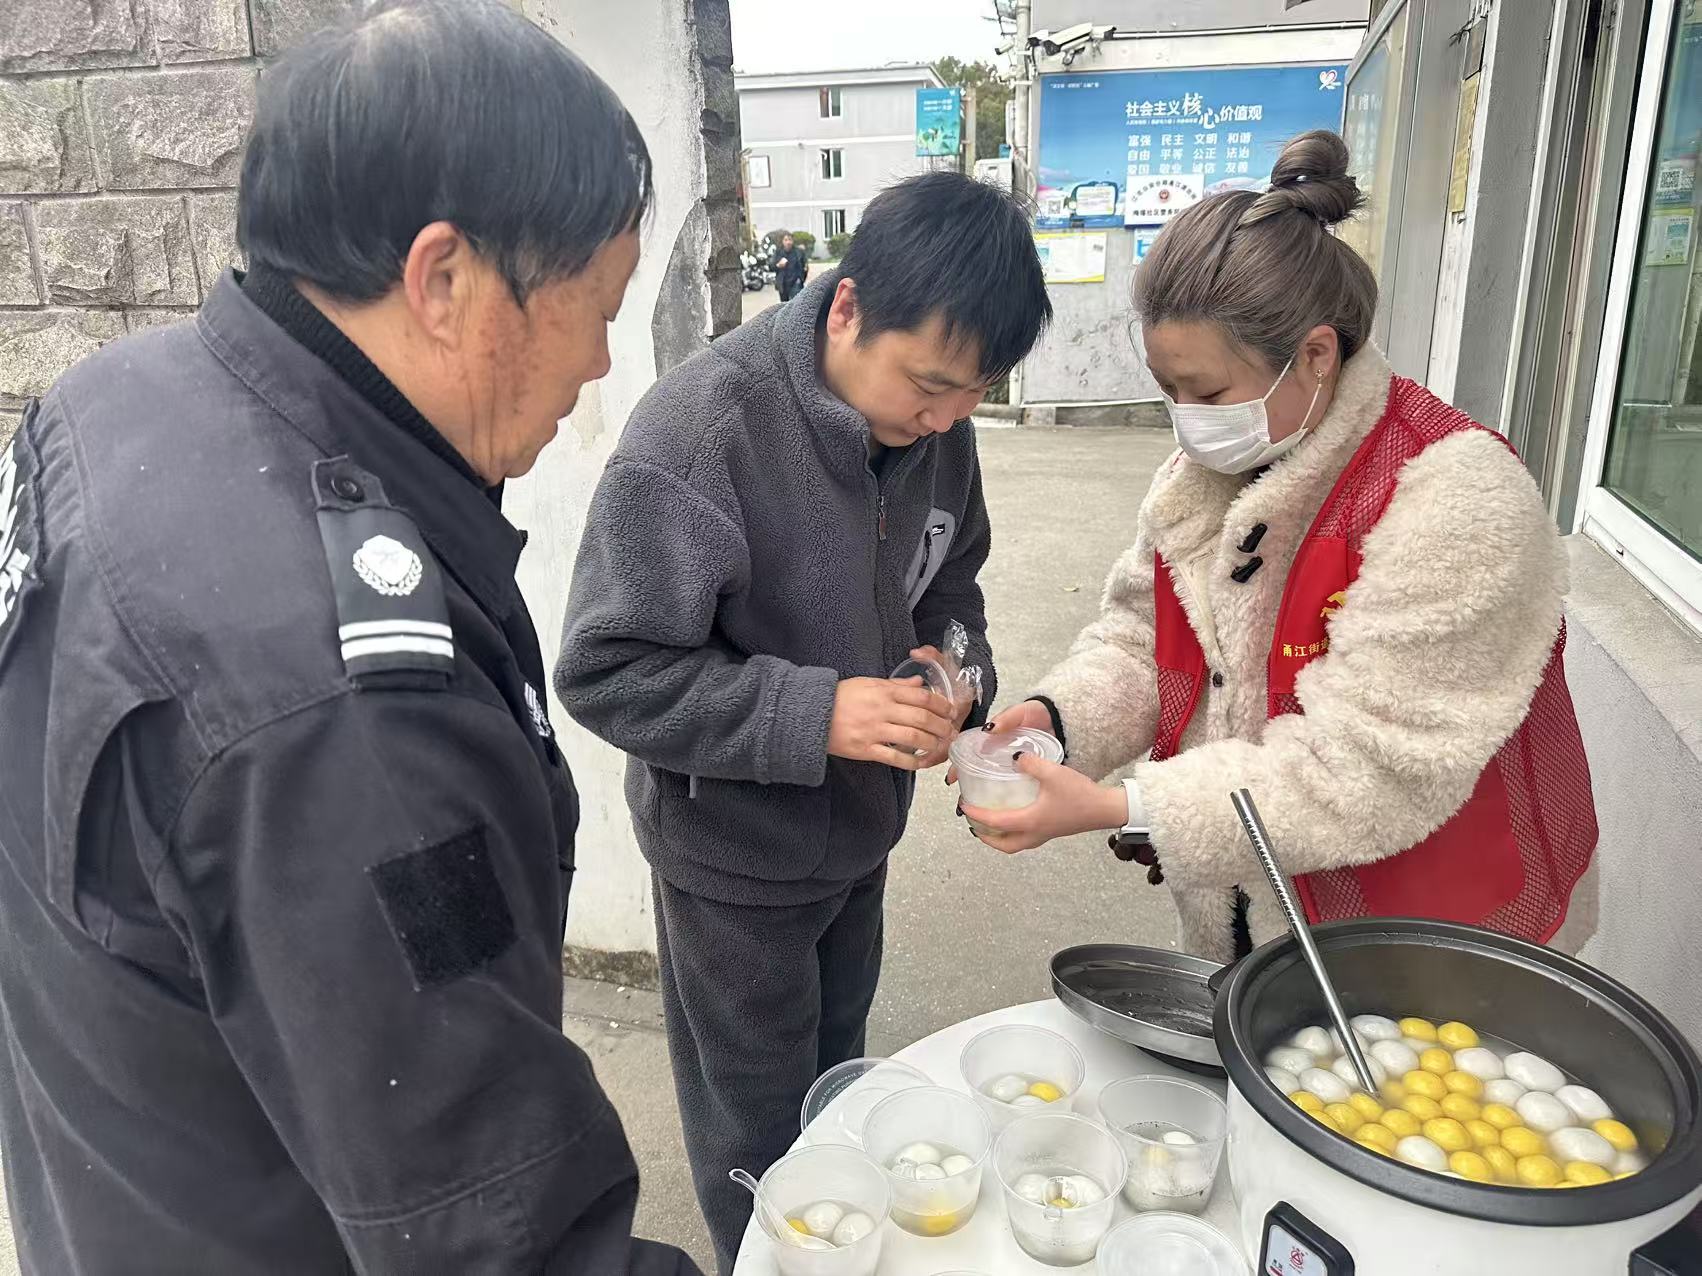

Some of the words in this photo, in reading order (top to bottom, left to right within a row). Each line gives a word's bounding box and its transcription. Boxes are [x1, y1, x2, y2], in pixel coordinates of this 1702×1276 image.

[1126, 92, 1263, 129] 社会主义核心价值观
[1129, 134, 1151, 146] 富强
[1162, 134, 1184, 145] 民主
[1194, 133, 1218, 145] 文明
[1227, 132, 1251, 144] 和谐
[1128, 149, 1150, 161] 自由
[1160, 148, 1184, 160] 平等
[1193, 147, 1216, 159] 公正
[1226, 146, 1250, 159] 法治
